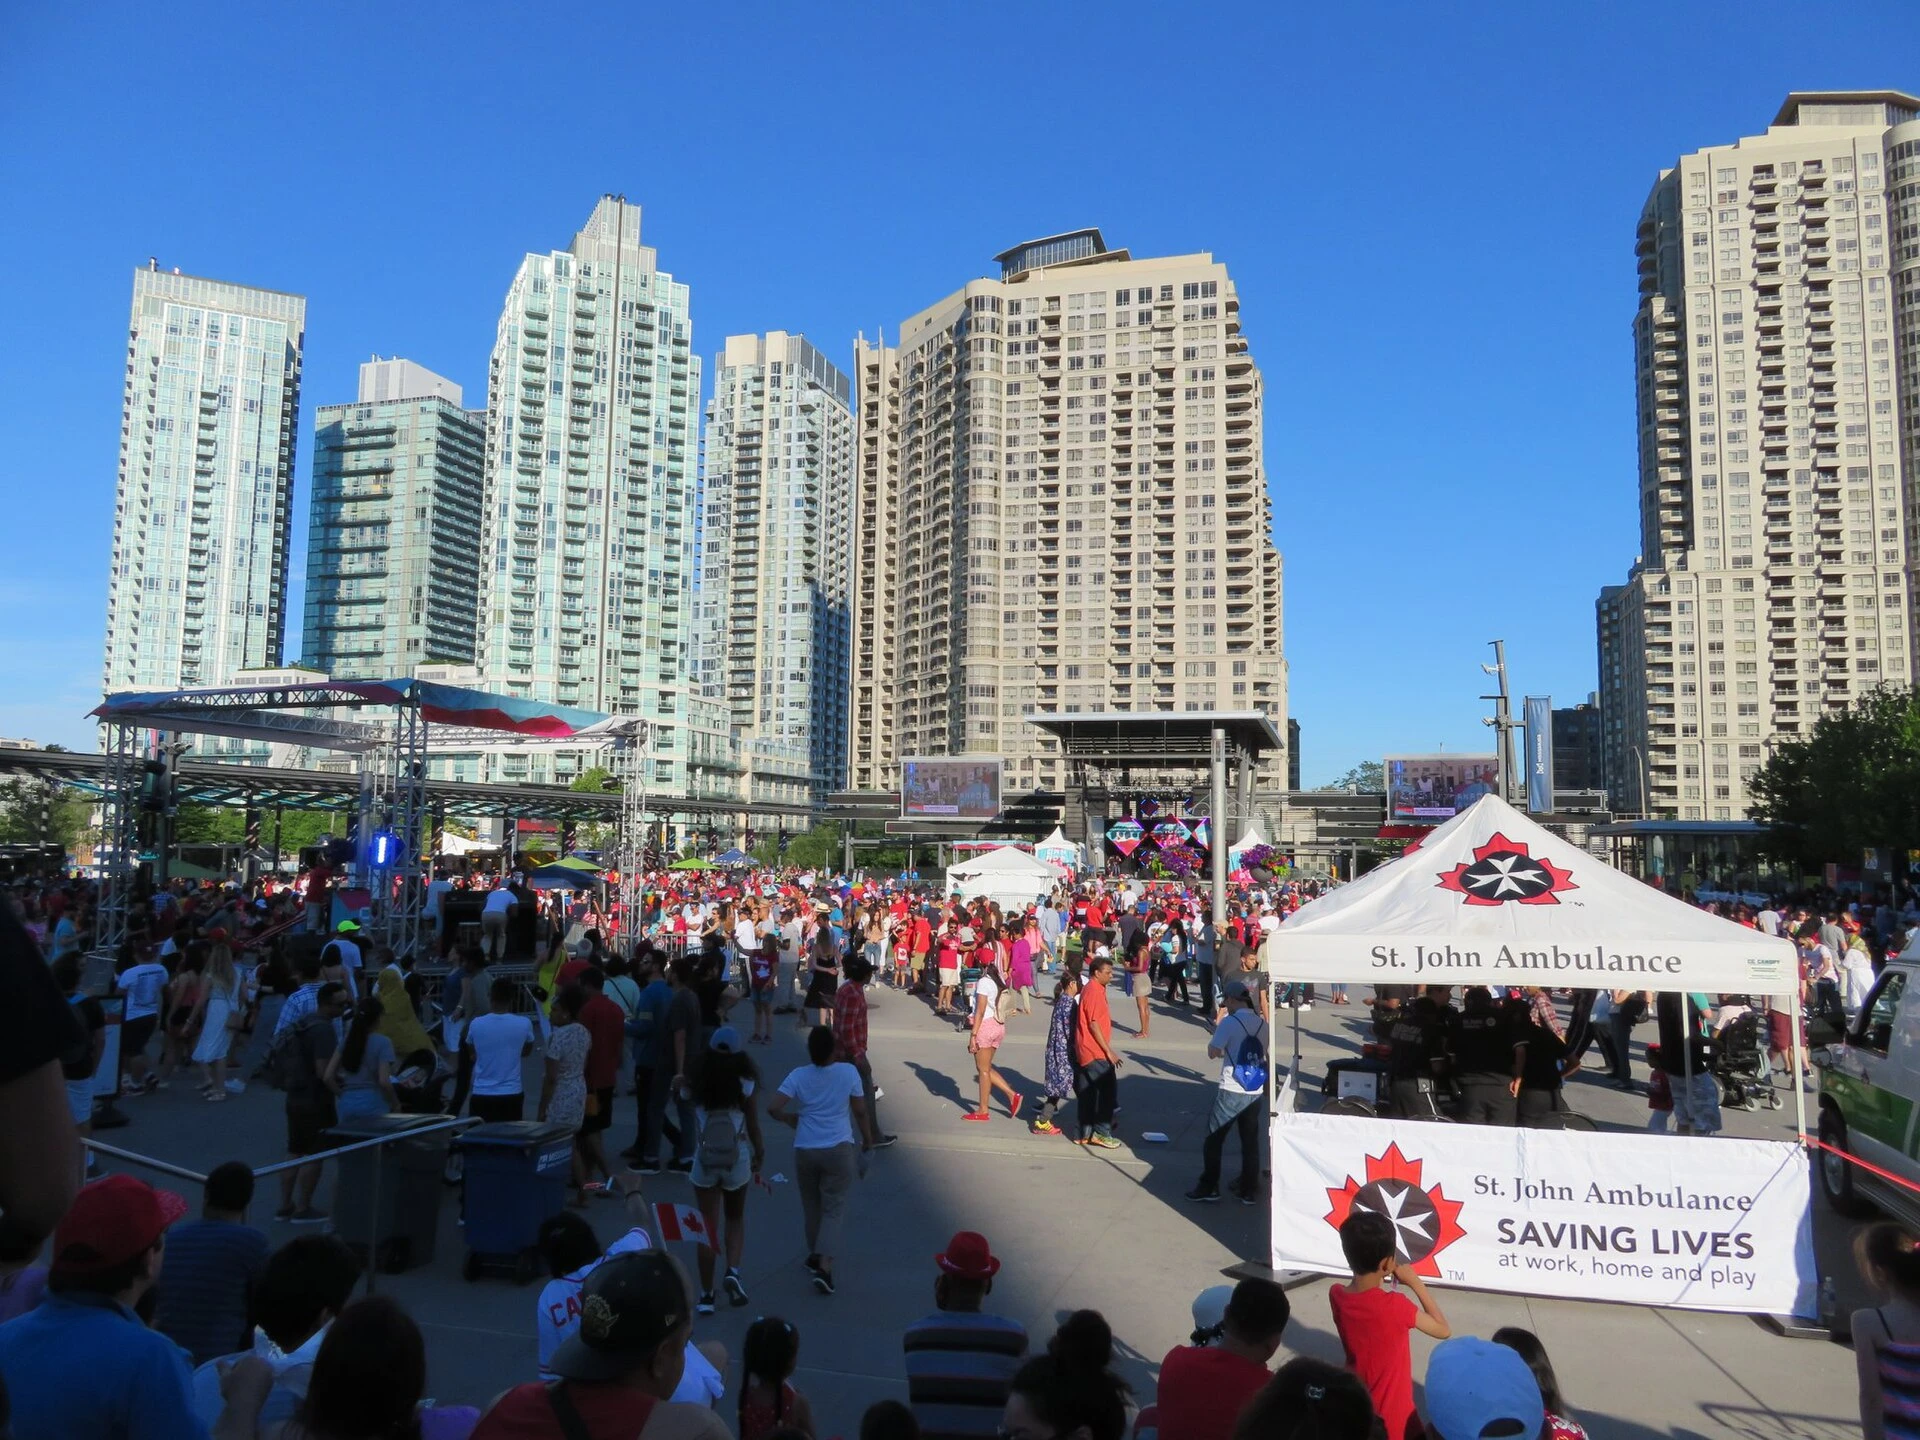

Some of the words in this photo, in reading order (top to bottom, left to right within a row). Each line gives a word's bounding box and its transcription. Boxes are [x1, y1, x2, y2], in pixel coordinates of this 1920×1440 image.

[1371, 945, 1406, 968] St.
[1414, 945, 1482, 973] John
[1493, 944, 1683, 974] Ambulance
[1474, 1174, 1506, 1197] St.
[1513, 1176, 1574, 1203] John
[1584, 1181, 1753, 1212] Ambulance
[1497, 1218, 1637, 1254] SAVING
[1652, 1228, 1755, 1260] LIVES
[1447, 1269, 1465, 1281] TM
[1498, 1251, 1518, 1268] at
[1525, 1254, 1584, 1276] work,
[1592, 1256, 1654, 1279] home
[1662, 1262, 1702, 1282] and
[1710, 1265, 1757, 1291] play
